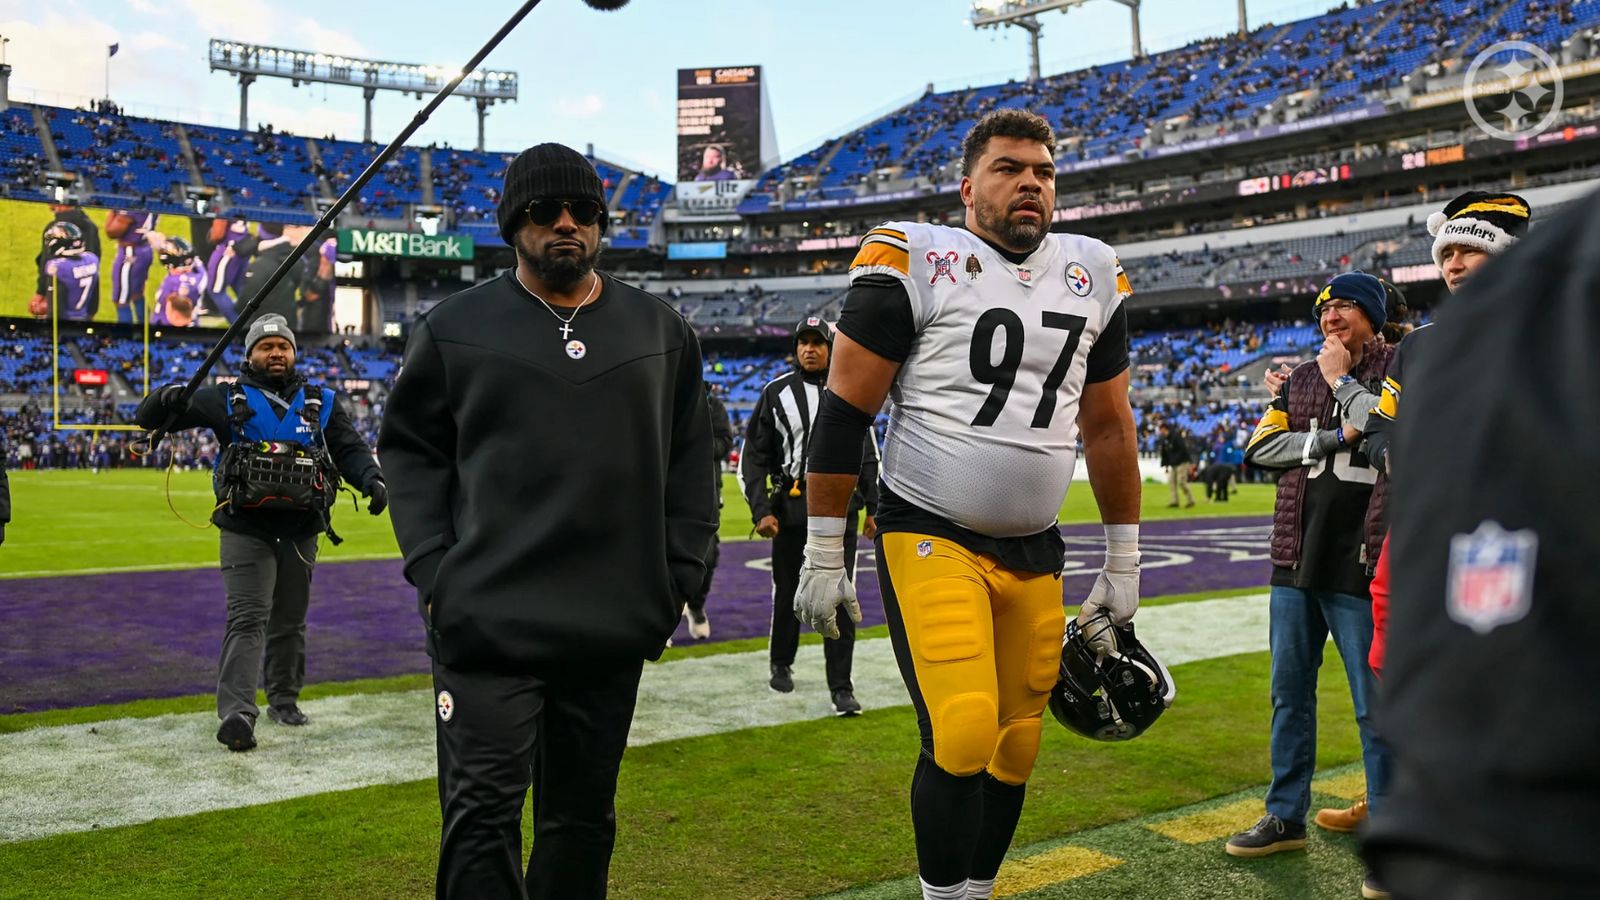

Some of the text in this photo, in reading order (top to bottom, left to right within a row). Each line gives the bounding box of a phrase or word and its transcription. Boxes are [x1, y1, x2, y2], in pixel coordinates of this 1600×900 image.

[715, 180, 738, 197] Lite
[351, 230, 461, 258] M&T Bank
[1445, 223, 1496, 243] Steelers
[969, 307, 1088, 429] 97
